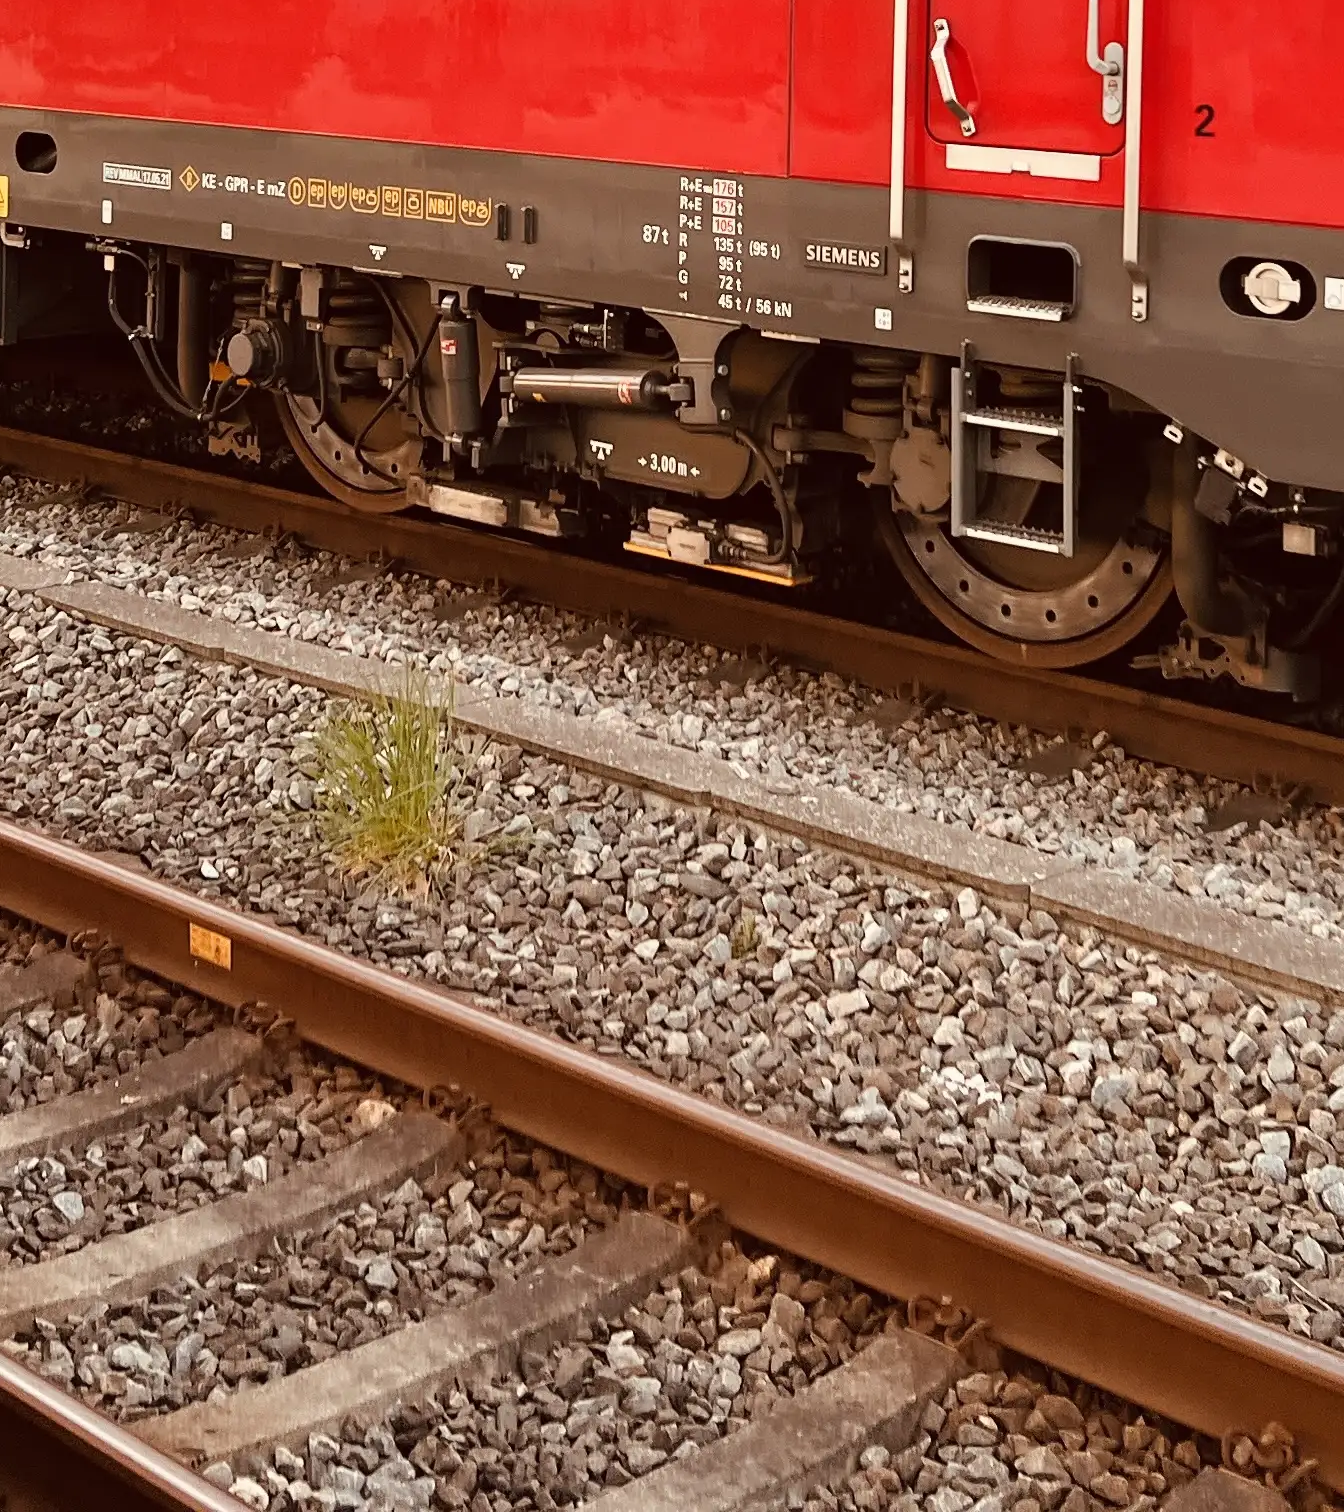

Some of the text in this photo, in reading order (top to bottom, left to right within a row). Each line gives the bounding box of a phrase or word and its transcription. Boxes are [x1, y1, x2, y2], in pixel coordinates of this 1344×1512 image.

[1195, 104, 1216, 137] 2
[201, 173, 217, 189] KE
[224, 175, 249, 194] GPR
[257, 179, 266, 195] E
[267, 181, 286, 198] mZ
[715, 181, 735, 196] 176
[737, 185, 744, 197] t
[679, 195, 743, 216] R+E 157 t
[642, 224, 669, 245] 87 t
[679, 214, 743, 235] P+E 105 t
[679, 232, 781, 260] R 135 t (95 t)
[806, 244, 880, 268] SIEMENS
[678, 251, 742, 273] P 95 t
[678, 269, 742, 292] G 72 t
[718, 294, 792, 318] 45 t / 56 kN
[677, 461, 688, 478] m
